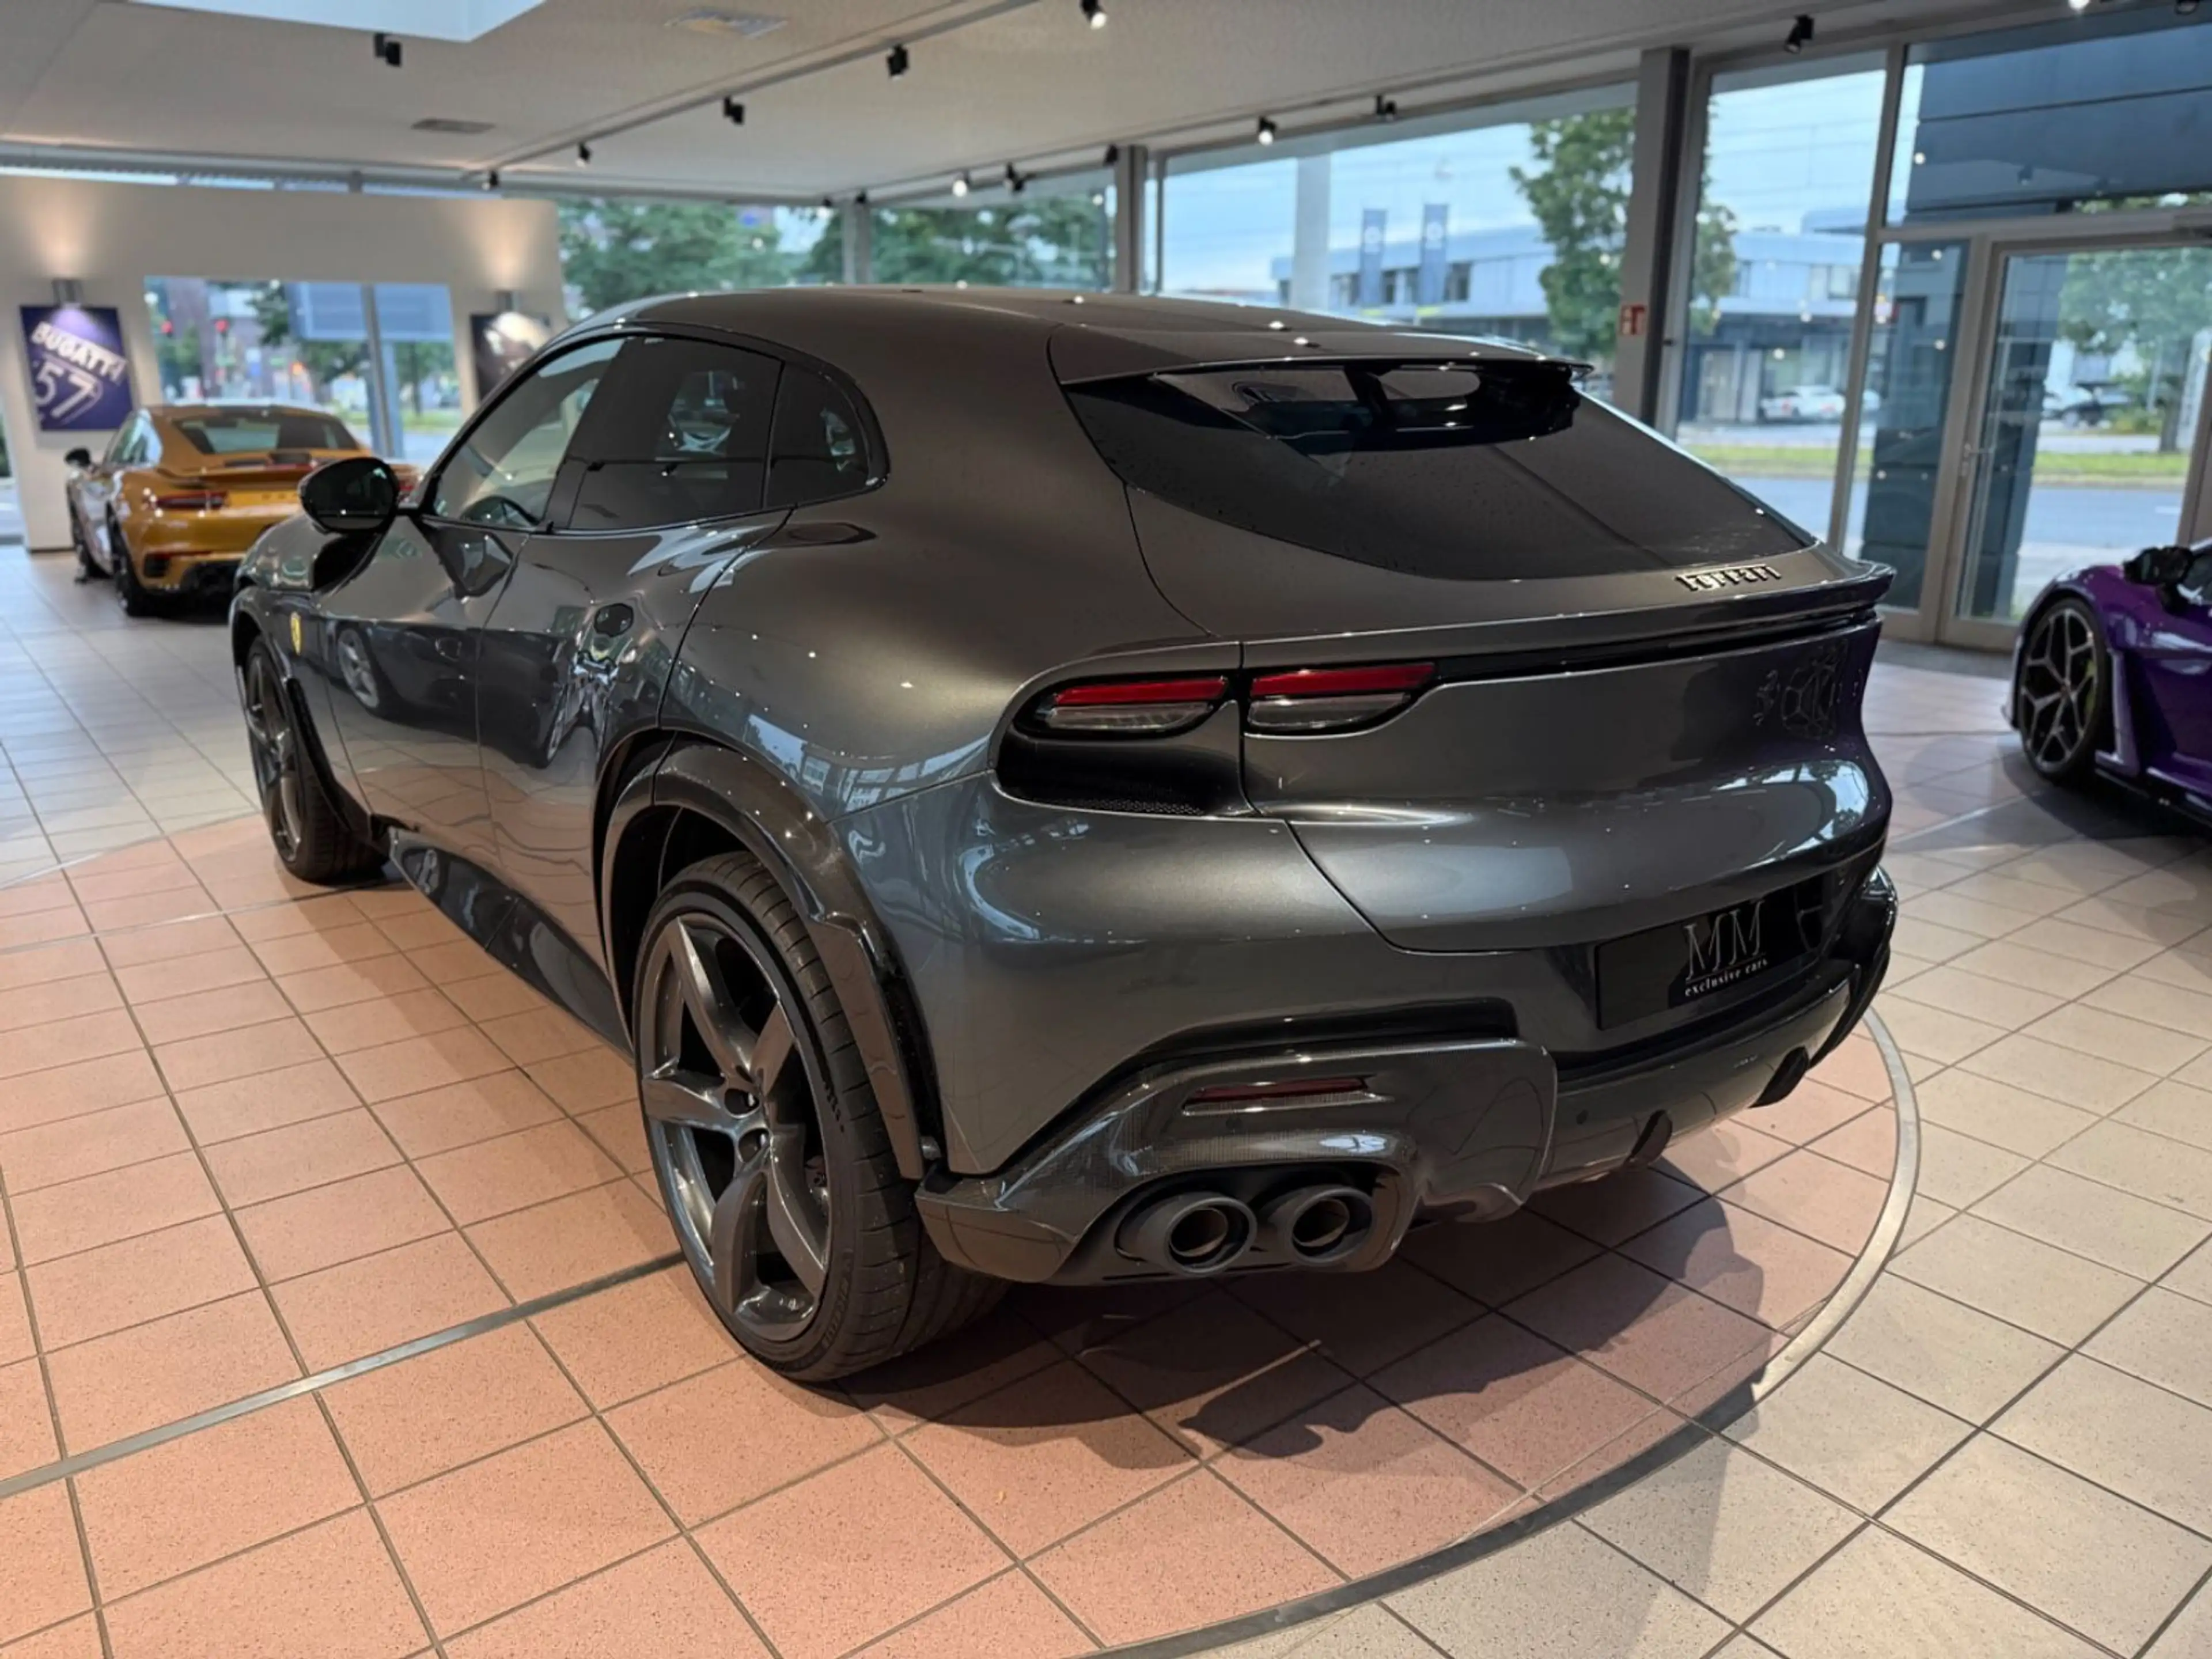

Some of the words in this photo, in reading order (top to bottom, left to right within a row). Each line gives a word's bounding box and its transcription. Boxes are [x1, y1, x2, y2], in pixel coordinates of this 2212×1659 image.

[31, 321, 127, 384] BUGATTI
[34, 357, 99, 420] 57
[1684, 899, 1765, 981] MM
[1685, 969, 1741, 997] exclusive
[1745, 957, 1769, 975] cars
